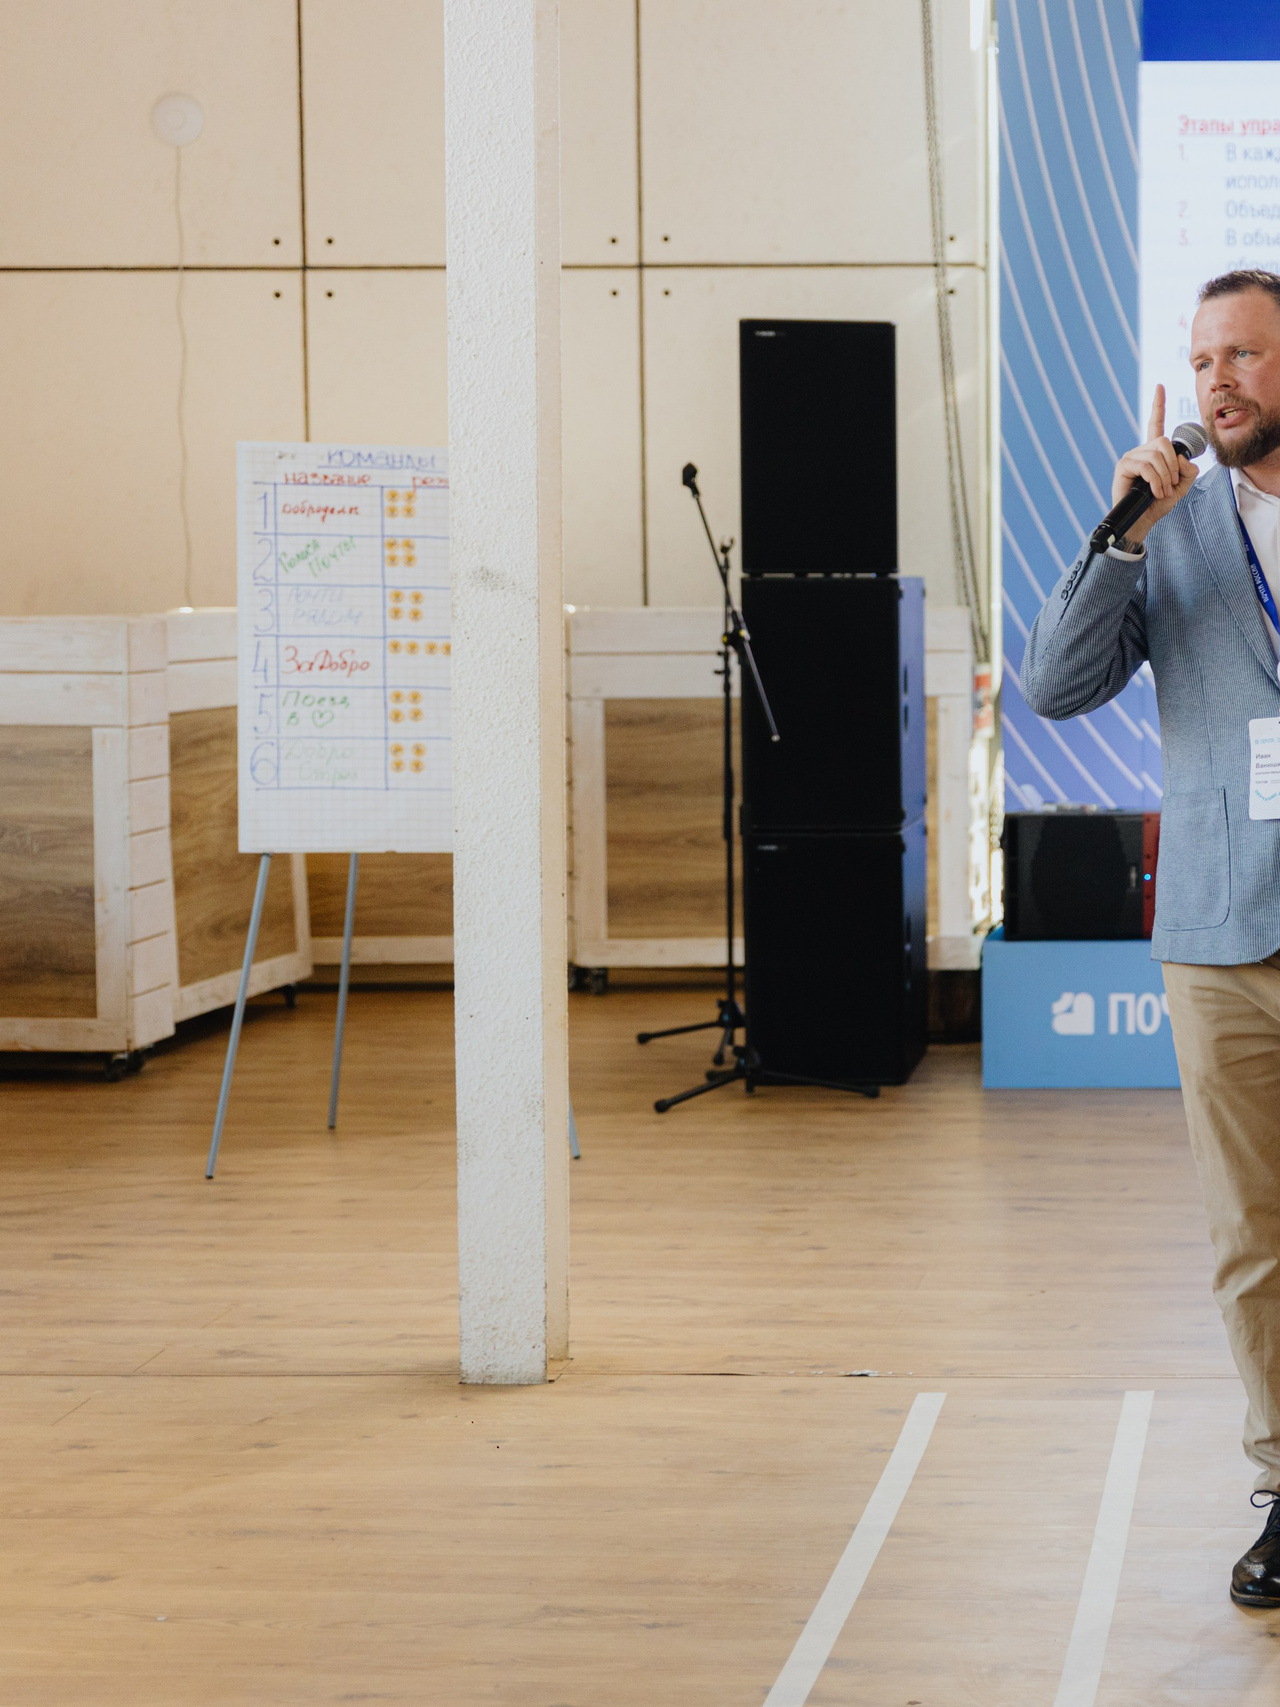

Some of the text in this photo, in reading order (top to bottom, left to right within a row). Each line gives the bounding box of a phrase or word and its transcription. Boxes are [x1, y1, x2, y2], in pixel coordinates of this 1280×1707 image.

[1179, 114, 1234, 135] Этапы
[1226, 143, 1236, 162] В
[1225, 229, 1237, 246] В
[257, 491, 268, 530] 1
[252, 538, 273, 583] 2
[254, 588, 275, 633] 3
[252, 640, 268, 683] 4
[253, 693, 273, 735] 5
[250, 740, 277, 785] 6
